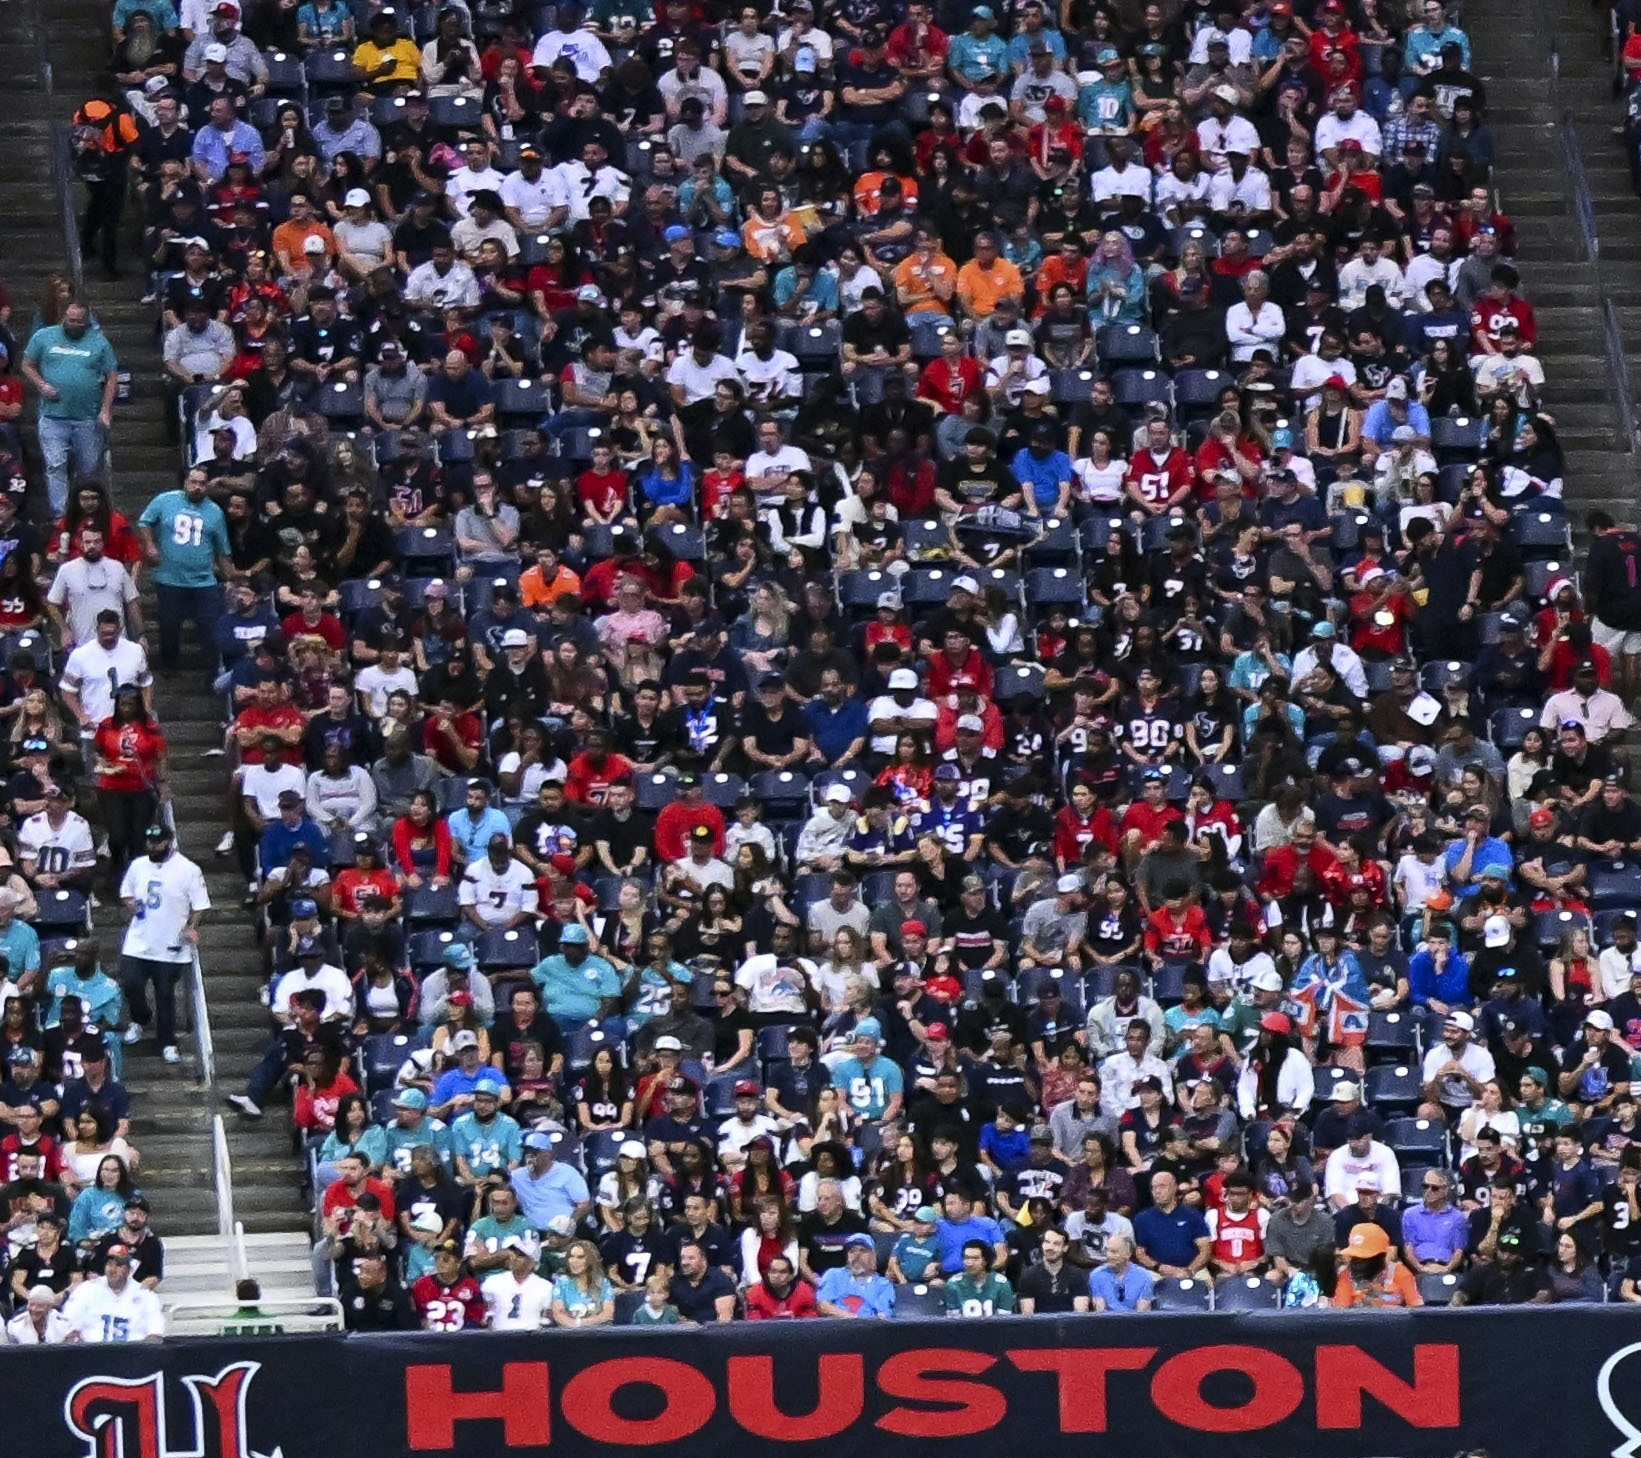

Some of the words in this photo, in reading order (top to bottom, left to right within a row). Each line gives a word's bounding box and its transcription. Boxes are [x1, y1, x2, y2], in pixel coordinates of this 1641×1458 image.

[1142, 472, 1169, 500] 51
[174, 515, 203, 546] 91
[39, 846, 70, 872] 10
[148, 881, 163, 909] 5
[625, 1252, 651, 1283] 7
[426, 1300, 464, 1332] 23
[405, 1344, 1461, 1450] HOUSTON
